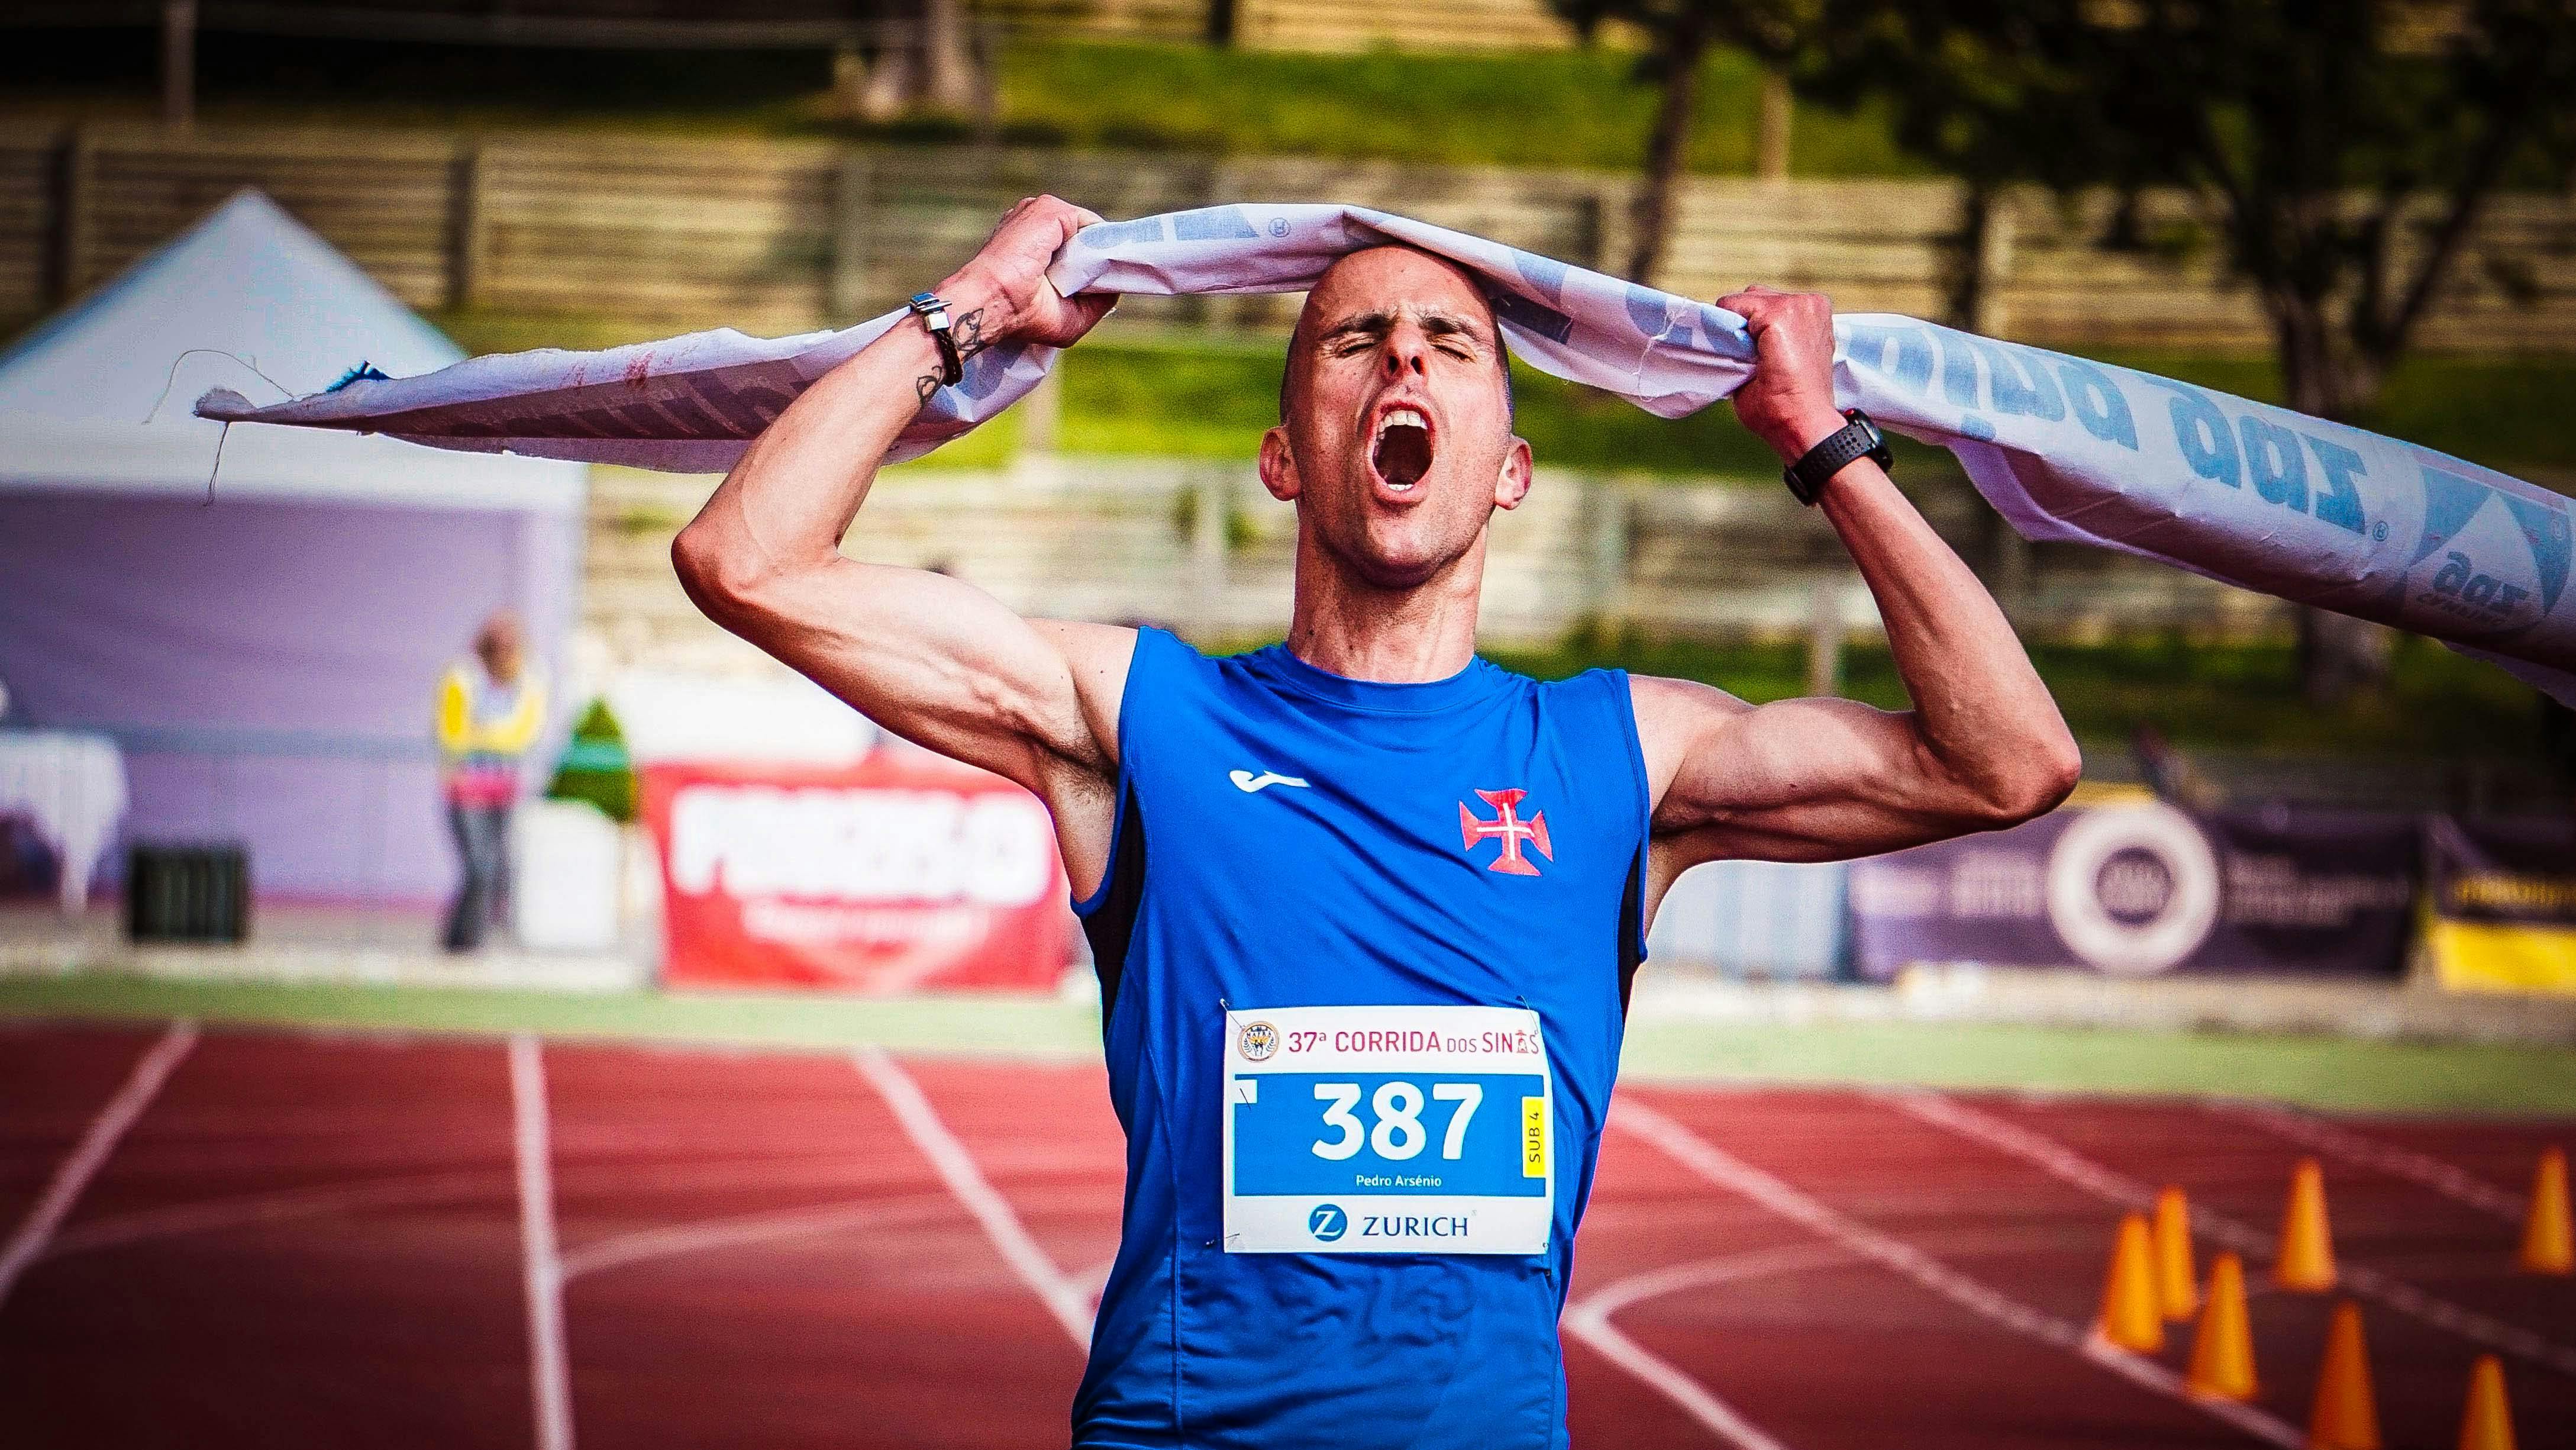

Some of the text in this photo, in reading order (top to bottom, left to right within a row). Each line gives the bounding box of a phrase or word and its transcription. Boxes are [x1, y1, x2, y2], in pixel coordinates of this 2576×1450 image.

[1335, 1031, 1442, 1053] CORRIDA
[1447, 1038, 1477, 1053] DOS
[1312, 1081, 1483, 1161] 387
[1529, 1112, 1541, 1164] SUB 4
[1355, 1174, 1442, 1187] Pedro Arsénio
[1362, 1216, 1468, 1236] ZURICH
